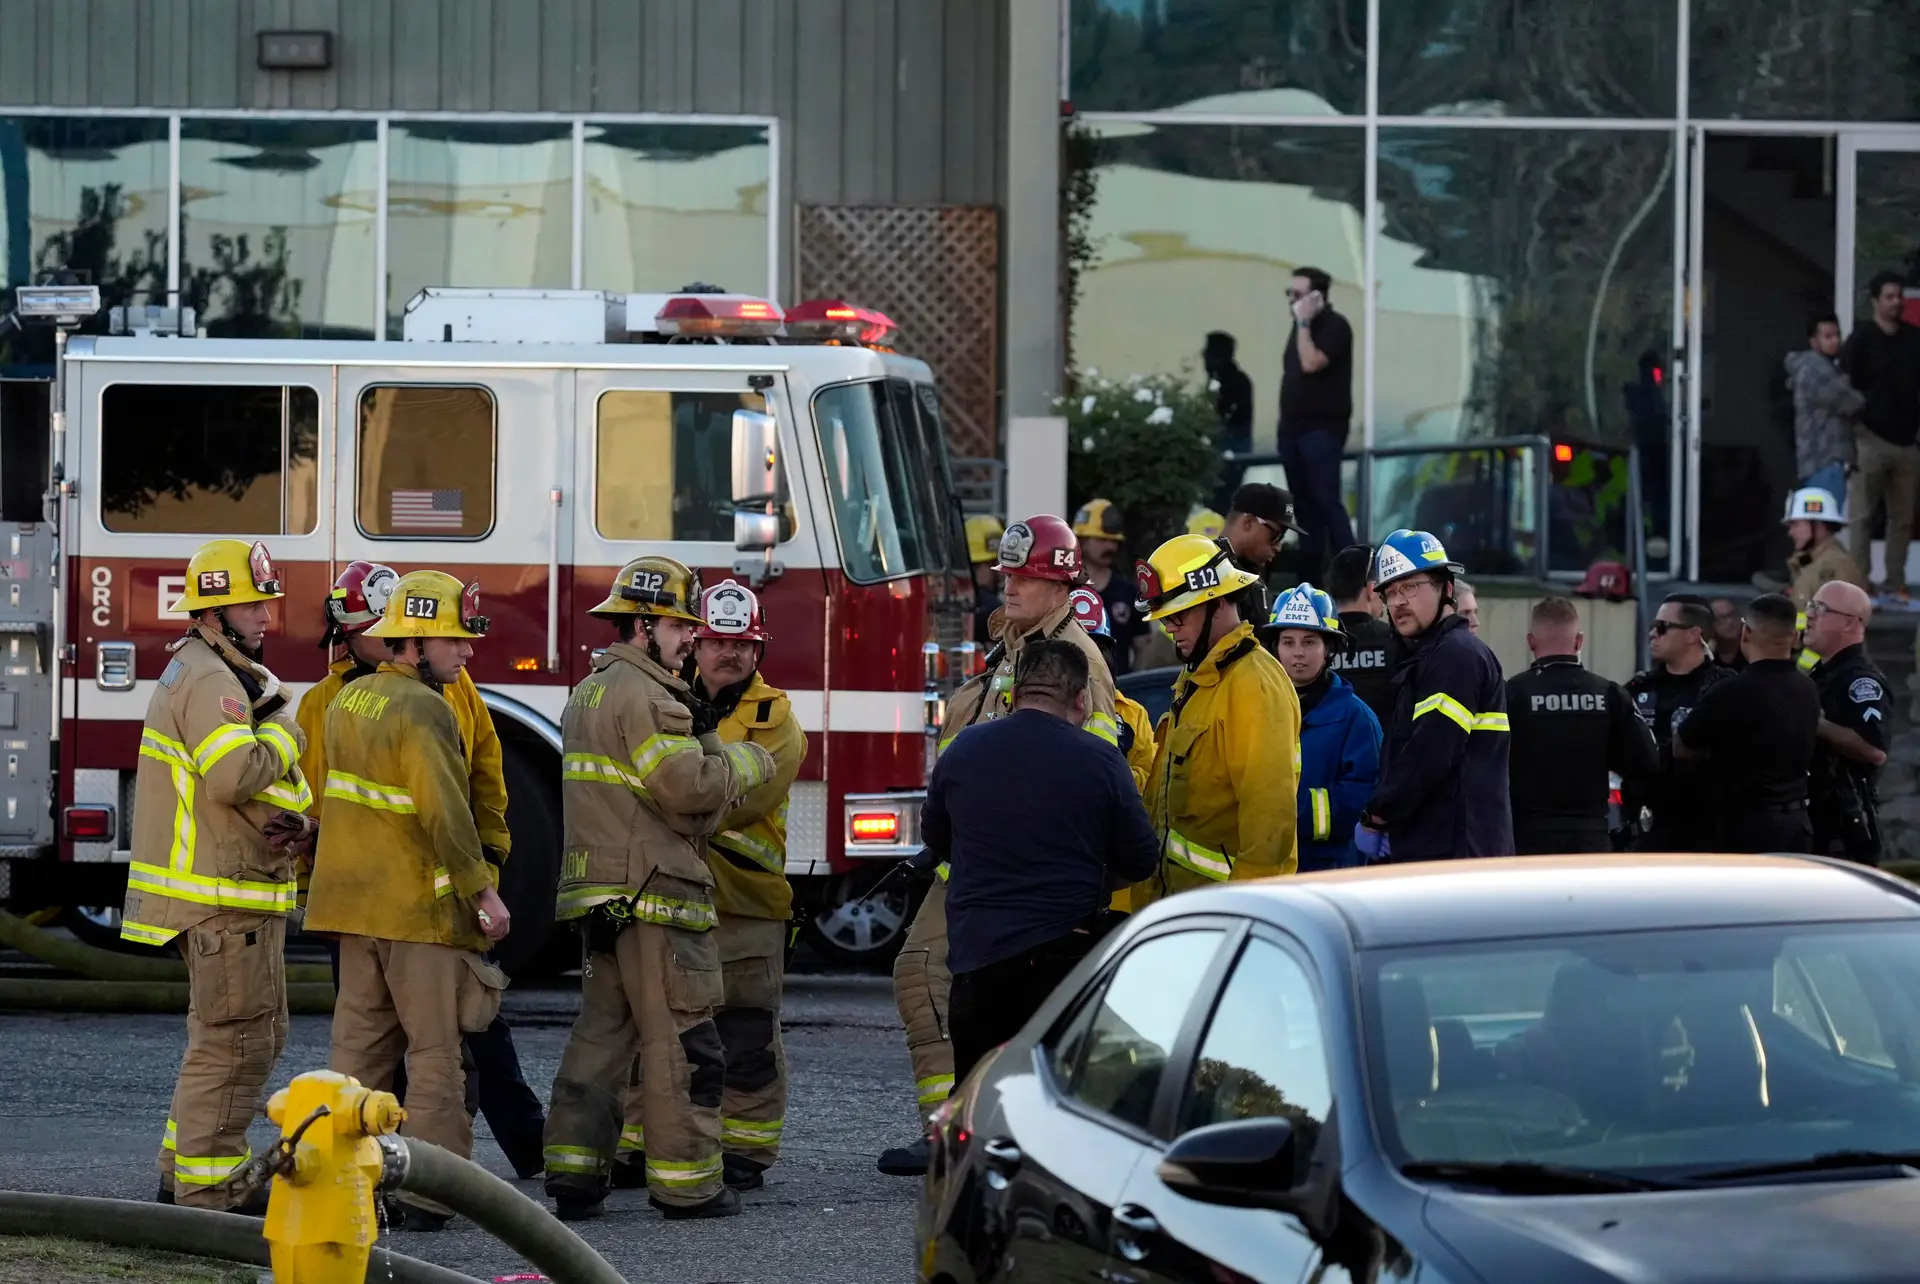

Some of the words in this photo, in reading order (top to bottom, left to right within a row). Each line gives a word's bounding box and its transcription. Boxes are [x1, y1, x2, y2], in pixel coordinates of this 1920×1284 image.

[1053, 549, 1075, 567] E4
[1381, 554, 1401, 569] CARE
[1383, 564, 1404, 577] EMT
[200, 572, 226, 590] E5
[631, 571, 663, 592] E12
[1286, 603, 1310, 612] CARE
[1285, 613, 1310, 621] EMT
[1329, 650, 1386, 670] OLICE
[330, 686, 390, 721] NAHEIM
[1531, 694, 1606, 711] POLICE
